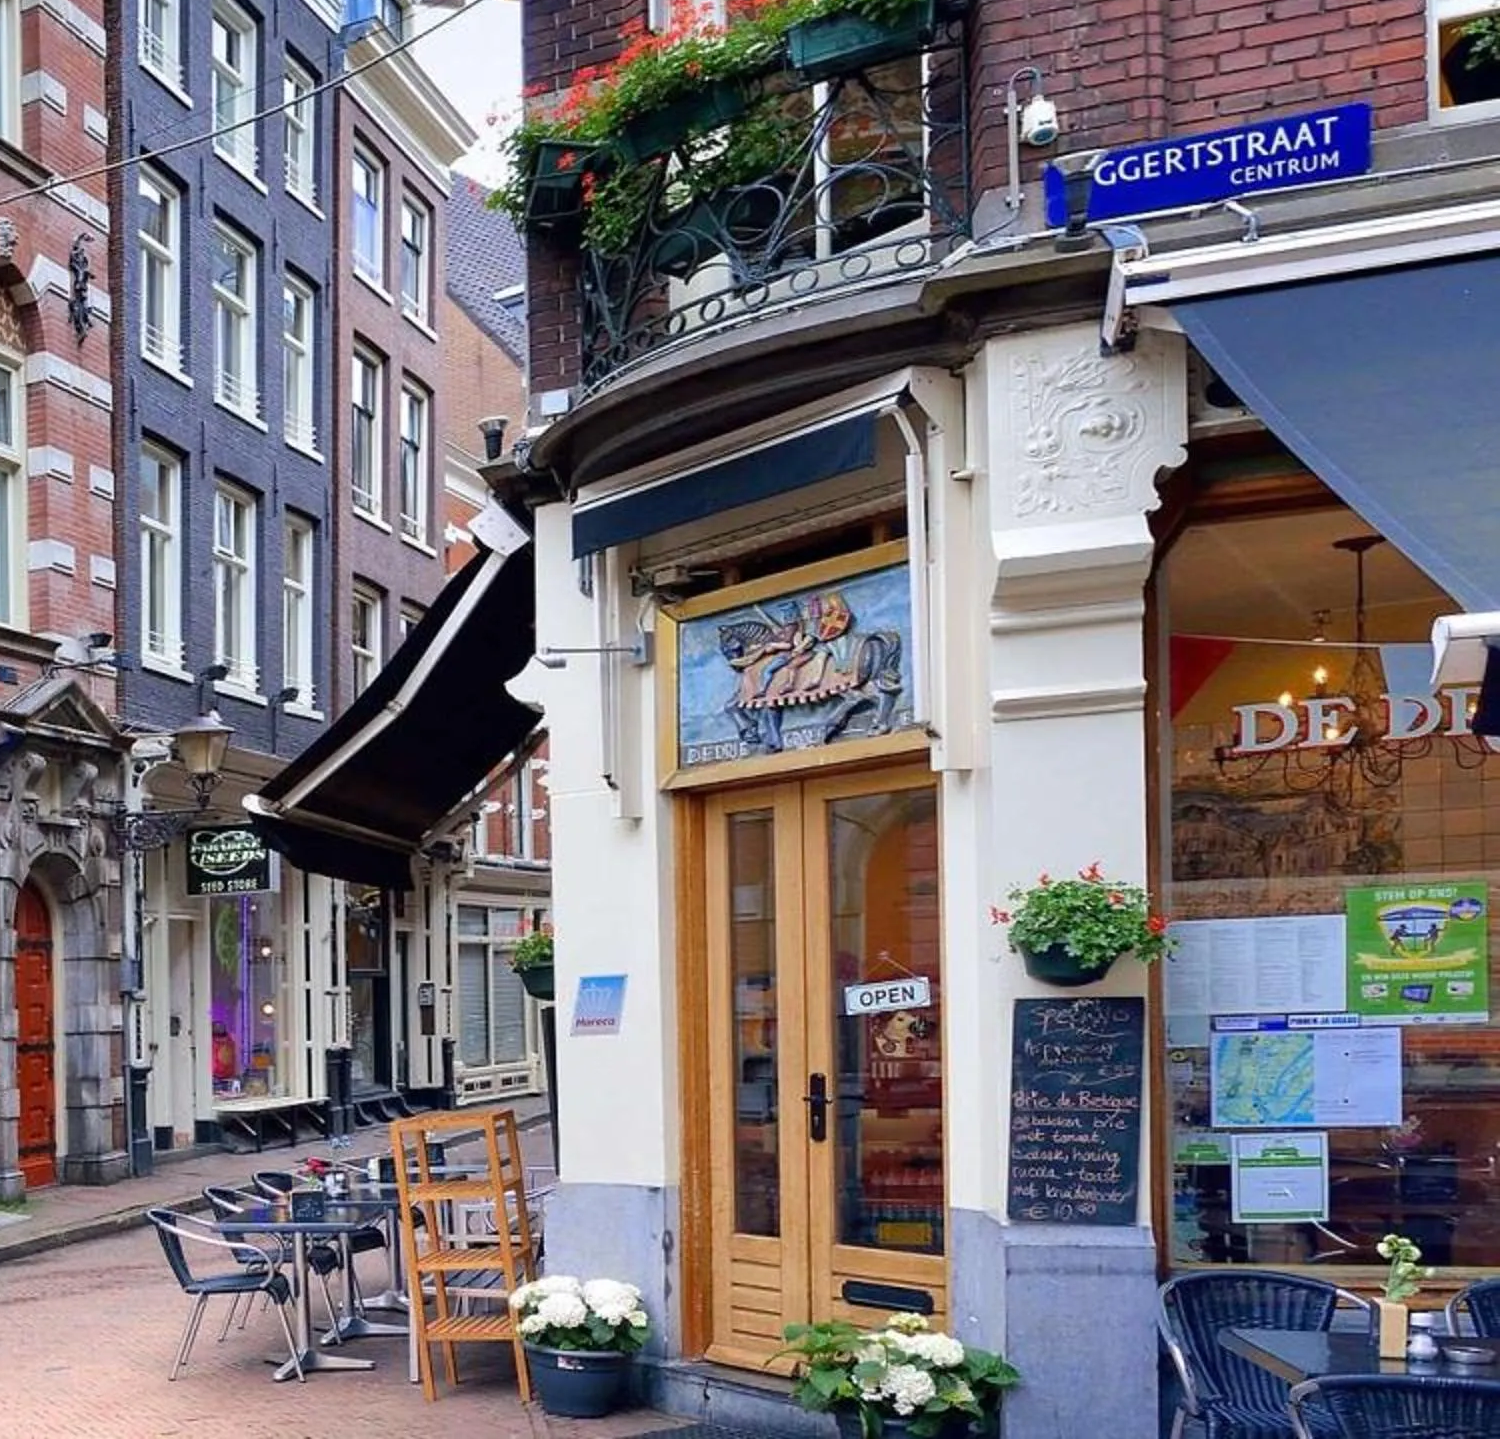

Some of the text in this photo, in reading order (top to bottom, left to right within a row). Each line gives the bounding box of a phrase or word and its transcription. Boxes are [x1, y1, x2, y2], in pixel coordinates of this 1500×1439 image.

[1091, 116, 1339, 186] GGERTSTRAAT
[1229, 151, 1340, 186] CENTRUM
[1231, 694, 1359, 754] DE
[859, 985, 915, 1007] OPEN
